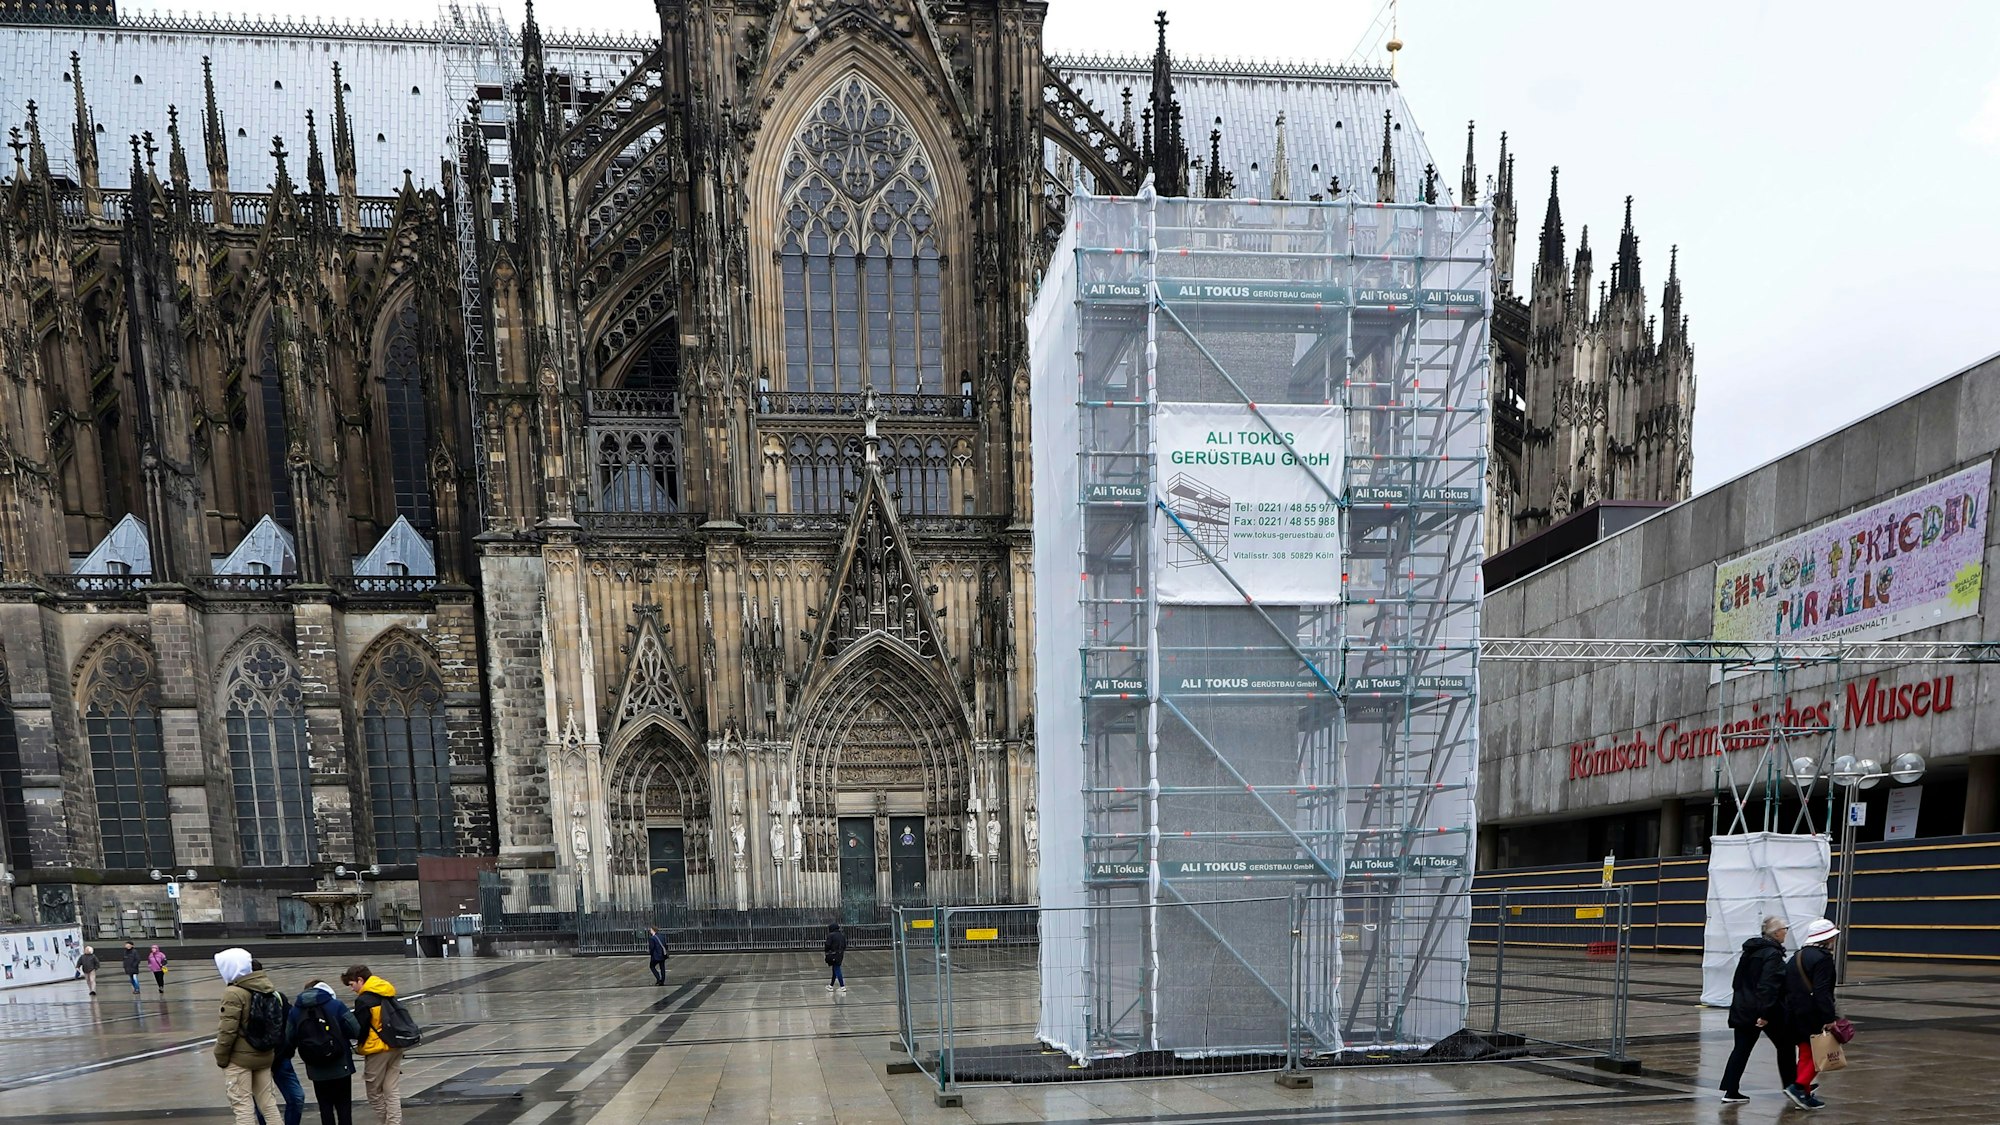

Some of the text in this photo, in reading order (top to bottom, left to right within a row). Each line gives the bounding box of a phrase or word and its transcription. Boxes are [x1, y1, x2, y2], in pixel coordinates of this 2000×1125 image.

[1108, 284, 1140, 294] Tokus
[1180, 286, 1322, 299] ALI TOKUS GERÜSTBAU GmbH
[1360, 290, 1408, 300] Ali Tokus
[1428, 292, 1475, 302] Ali Tokus
[1206, 431, 1294, 445] ALI TOKUS
[1171, 449, 1329, 466] GERÜSTBAU GmbH
[1092, 486, 1142, 496] Ali Tokus
[1356, 489, 1403, 498] Ali Tokus
[1422, 489, 1468, 499] Ali Tokus
[1234, 502, 1253, 512] Tel:
[1258, 503, 1281, 512] 0221
[1290, 503, 1302, 512] 48
[1304, 504, 1316, 512] 55
[1319, 504, 1336, 512] 977
[1234, 517, 1256, 526] Fax:
[1258, 517, 1281, 526] 0221
[1290, 517, 1302, 526] 48
[1304, 517, 1316, 526] 55
[1318, 517, 1335, 526] 988
[1234, 531, 1335, 540] www.tokus-geruestbau.de
[1094, 680, 1142, 689] Ali Tokus
[1181, 679, 1200, 688] ALI
[1205, 678, 1248, 688] TOKUS
[1251, 680, 1294, 688] GERÜSTBAU
[1355, 679, 1400, 689] Ali Tokus
[1418, 678, 1463, 686] Ali Tokus
[1844, 675, 1954, 731] Museu
[1350, 860, 1394, 869] Ali Tokus
[1413, 857, 1458, 866] Ali Tokus
[1097, 864, 1144, 874] Ali Tokus
[1181, 863, 1200, 872] ALI
[1204, 862, 1246, 871] TOKUS
[1250, 863, 1292, 871] GERÜSTBAU
